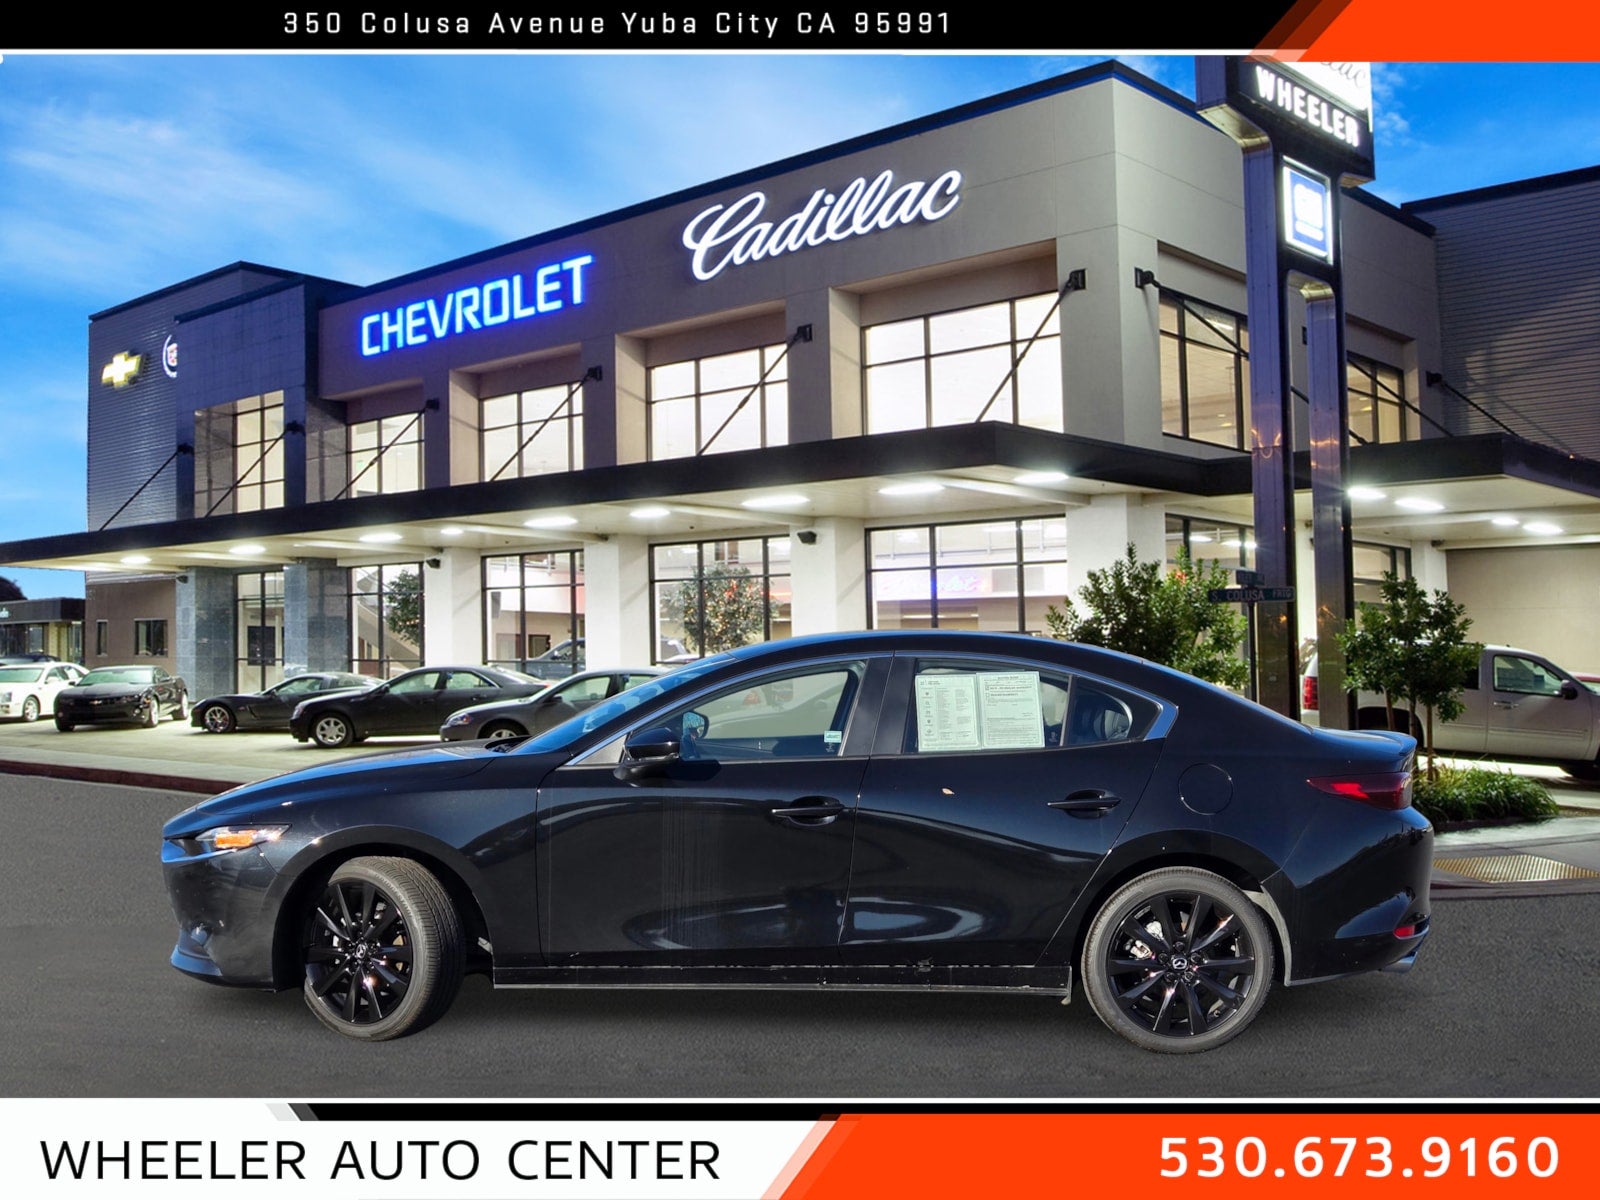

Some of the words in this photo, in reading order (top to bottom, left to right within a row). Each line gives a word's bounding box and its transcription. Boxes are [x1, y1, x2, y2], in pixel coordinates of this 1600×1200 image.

[1255, 65, 1361, 147] WHEELER
[682, 169, 962, 281] Cadillac
[361, 254, 593, 357] CHEVROLET
[1226, 589, 1265, 602] COLUSA
